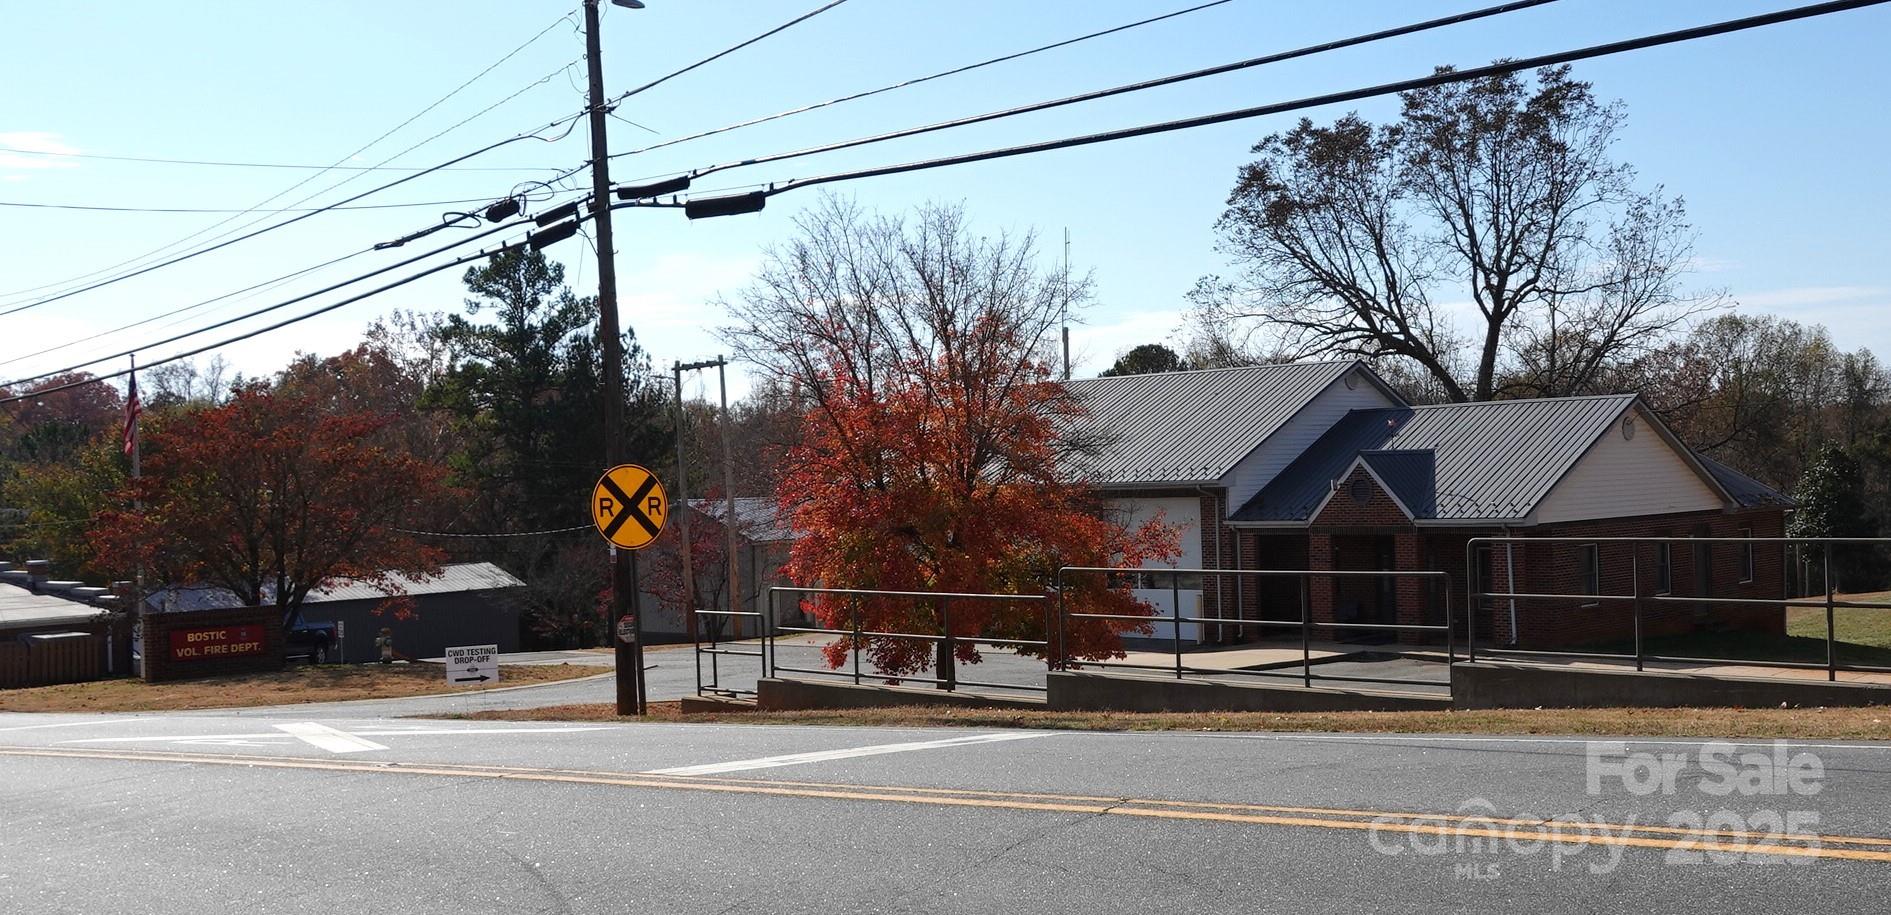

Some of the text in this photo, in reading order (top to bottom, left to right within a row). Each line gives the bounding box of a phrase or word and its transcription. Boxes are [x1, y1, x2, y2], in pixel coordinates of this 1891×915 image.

[599, 496, 662, 517] R R
[187, 631, 227, 642] BOSTIC
[176, 642, 261, 657] VOL. FIRE DEPT.
[447, 647, 496, 657] CWD TESTING
[454, 655, 490, 664] DROP-OFF
